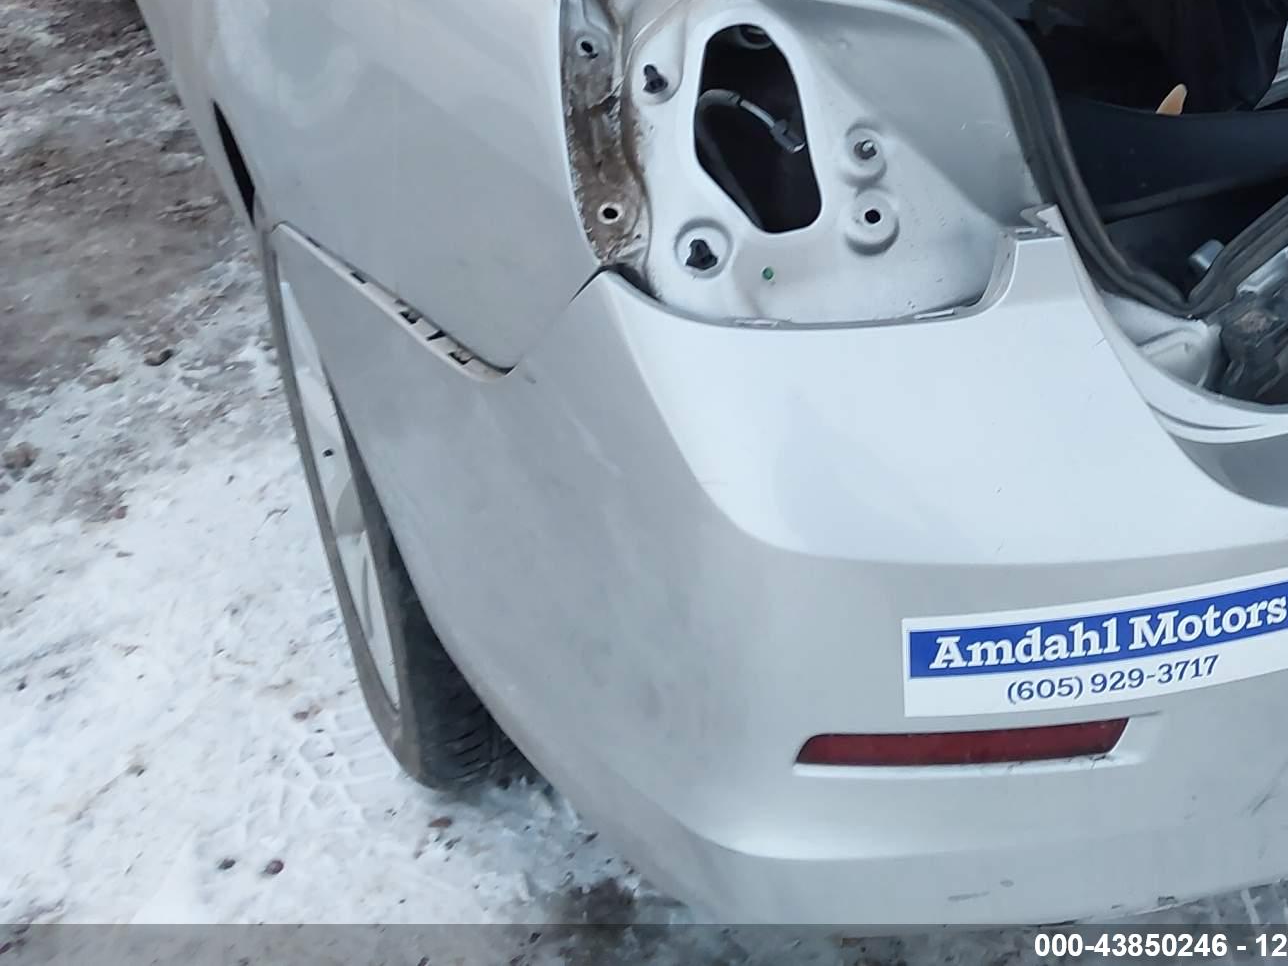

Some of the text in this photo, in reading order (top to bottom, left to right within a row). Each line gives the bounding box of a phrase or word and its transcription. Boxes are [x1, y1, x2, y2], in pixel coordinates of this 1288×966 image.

[928, 595, 1288, 670] Amdahl Motors
[1007, 654, 1219, 705] (605) 929-3717
